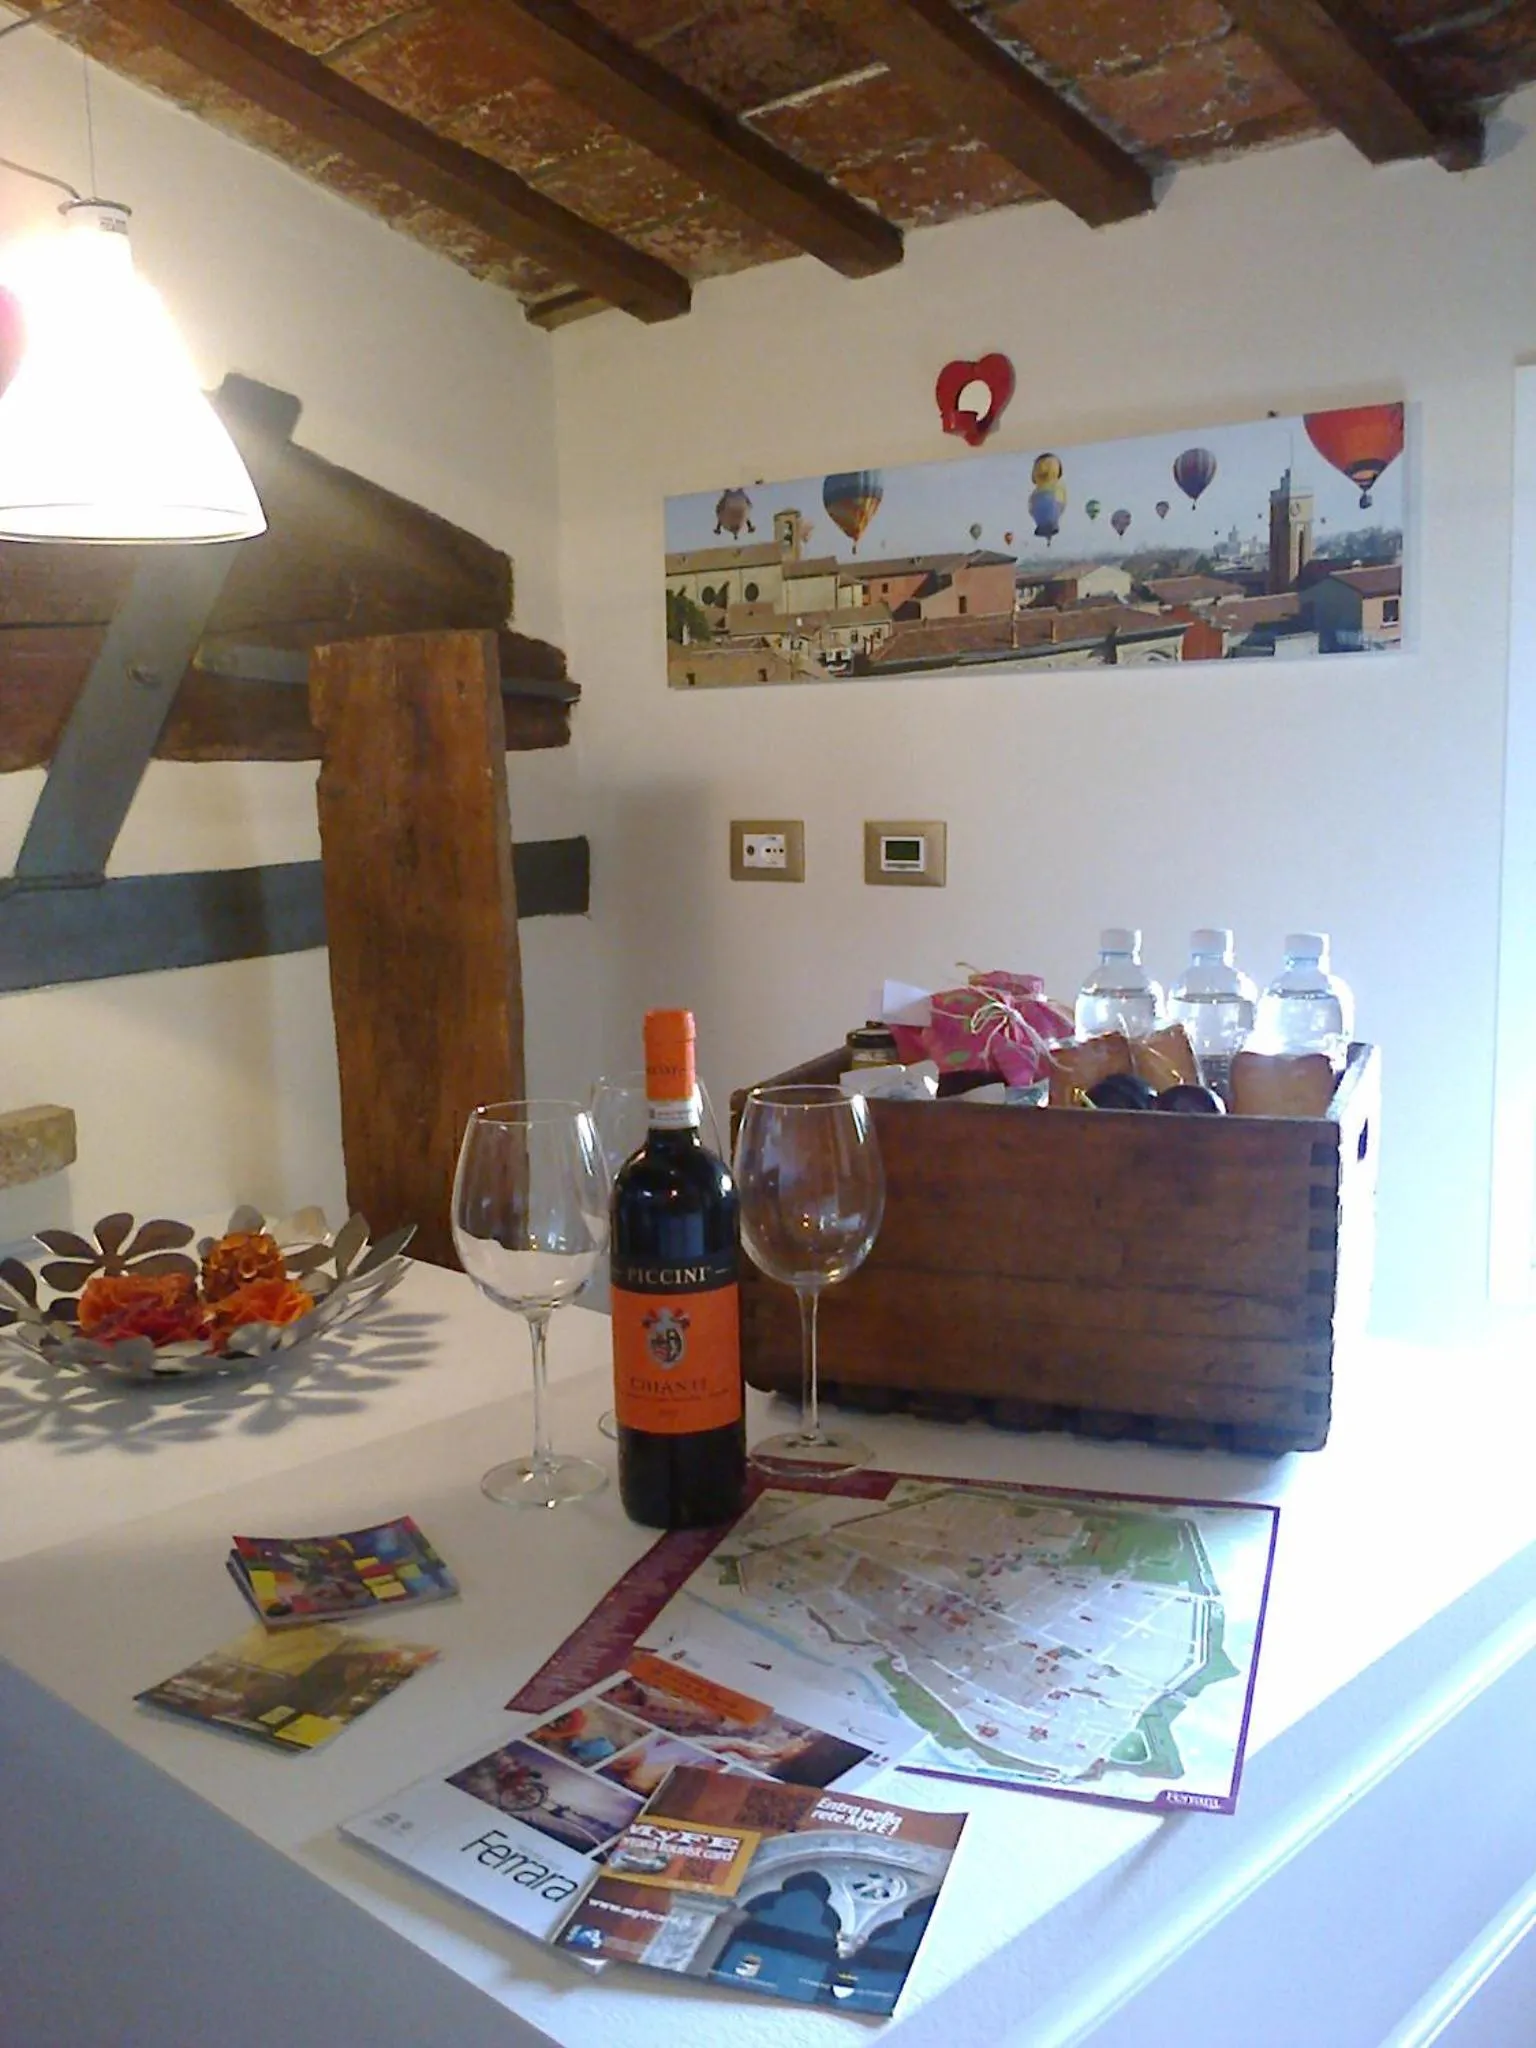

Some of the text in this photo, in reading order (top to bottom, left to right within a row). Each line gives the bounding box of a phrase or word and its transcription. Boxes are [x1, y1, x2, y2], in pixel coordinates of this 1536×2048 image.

[628, 1267, 706, 1285] PICCINI
[630, 1376, 708, 1396] CHIANTI
[461, 1829, 578, 1902] Ferrara
